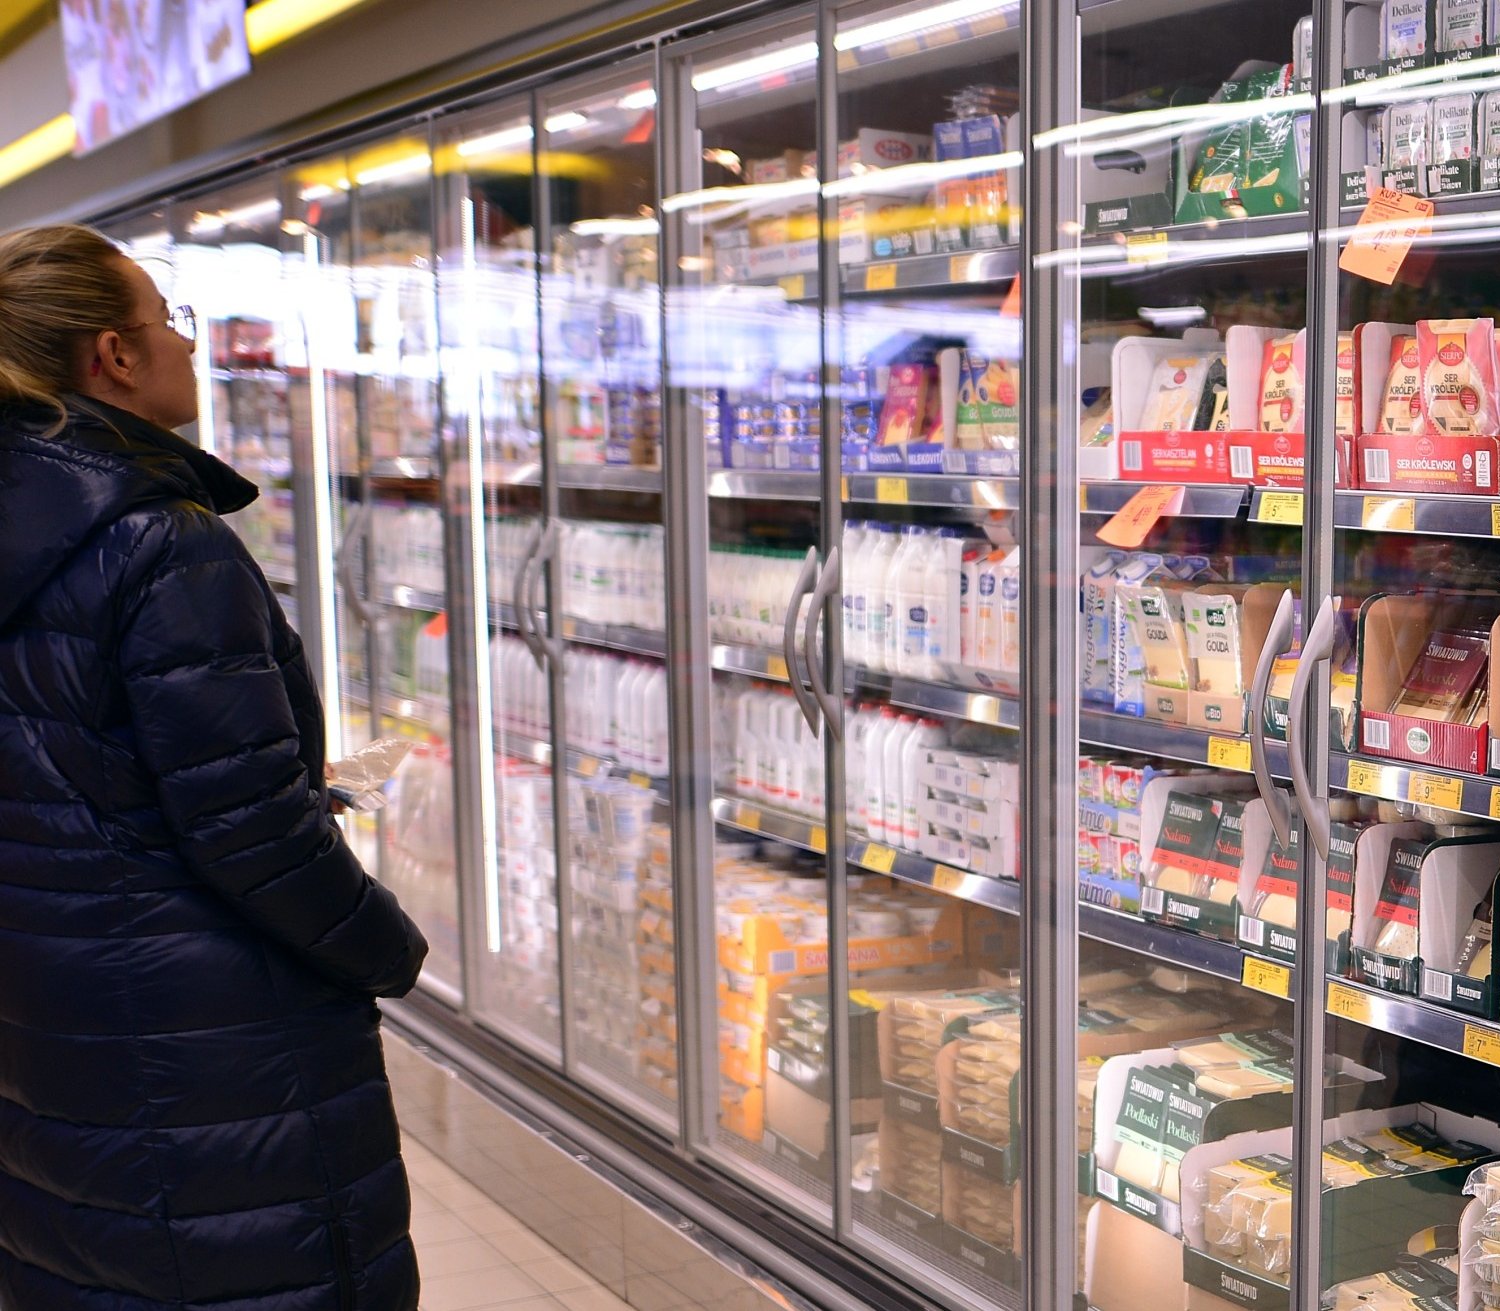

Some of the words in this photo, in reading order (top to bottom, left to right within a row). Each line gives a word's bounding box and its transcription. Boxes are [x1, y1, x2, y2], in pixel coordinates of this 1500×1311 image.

[1392, 4, 1422, 17] Delikate
[1440, 107, 1469, 119] Delikate
[1380, 189, 1396, 199] KUP
[1441, 352, 1462, 360] SIERPC
[1404, 376, 1416, 384] SER
[1444, 374, 1458, 383] SER
[1258, 455, 1270, 465] SER
[1270, 454, 1304, 466] KRÓLEWS
[1397, 460, 1411, 469] SER
[1412, 458, 1455, 470] KRÓLEWSKI
[1147, 629, 1168, 640] GOUDA
[1207, 641, 1229, 652] GOUDA
[1426, 643, 1468, 662] ŚWIATOWID
[1359, 774, 1363, 785] 9
[1425, 786, 1430, 798] 9
[1170, 800, 1202, 822] ŚWIATOWID
[1163, 826, 1191, 845] Salami
[1216, 839, 1241, 858] Salam
[1168, 900, 1199, 919] ŚWIATOWID
[1362, 956, 1401, 980] ŚWIATOWID
[1477, 1039, 1481, 1051] 7
[1130, 1076, 1164, 1102] ŚWIATOWID
[1169, 1091, 1203, 1119] ŚWIATOWID
[1124, 1102, 1159, 1130] Podlaski
[1166, 1119, 1200, 1145] Podlaski
[1124, 1188, 1157, 1215] ŚWIATOWID
[1221, 1271, 1257, 1300] ŚWIATOWID
